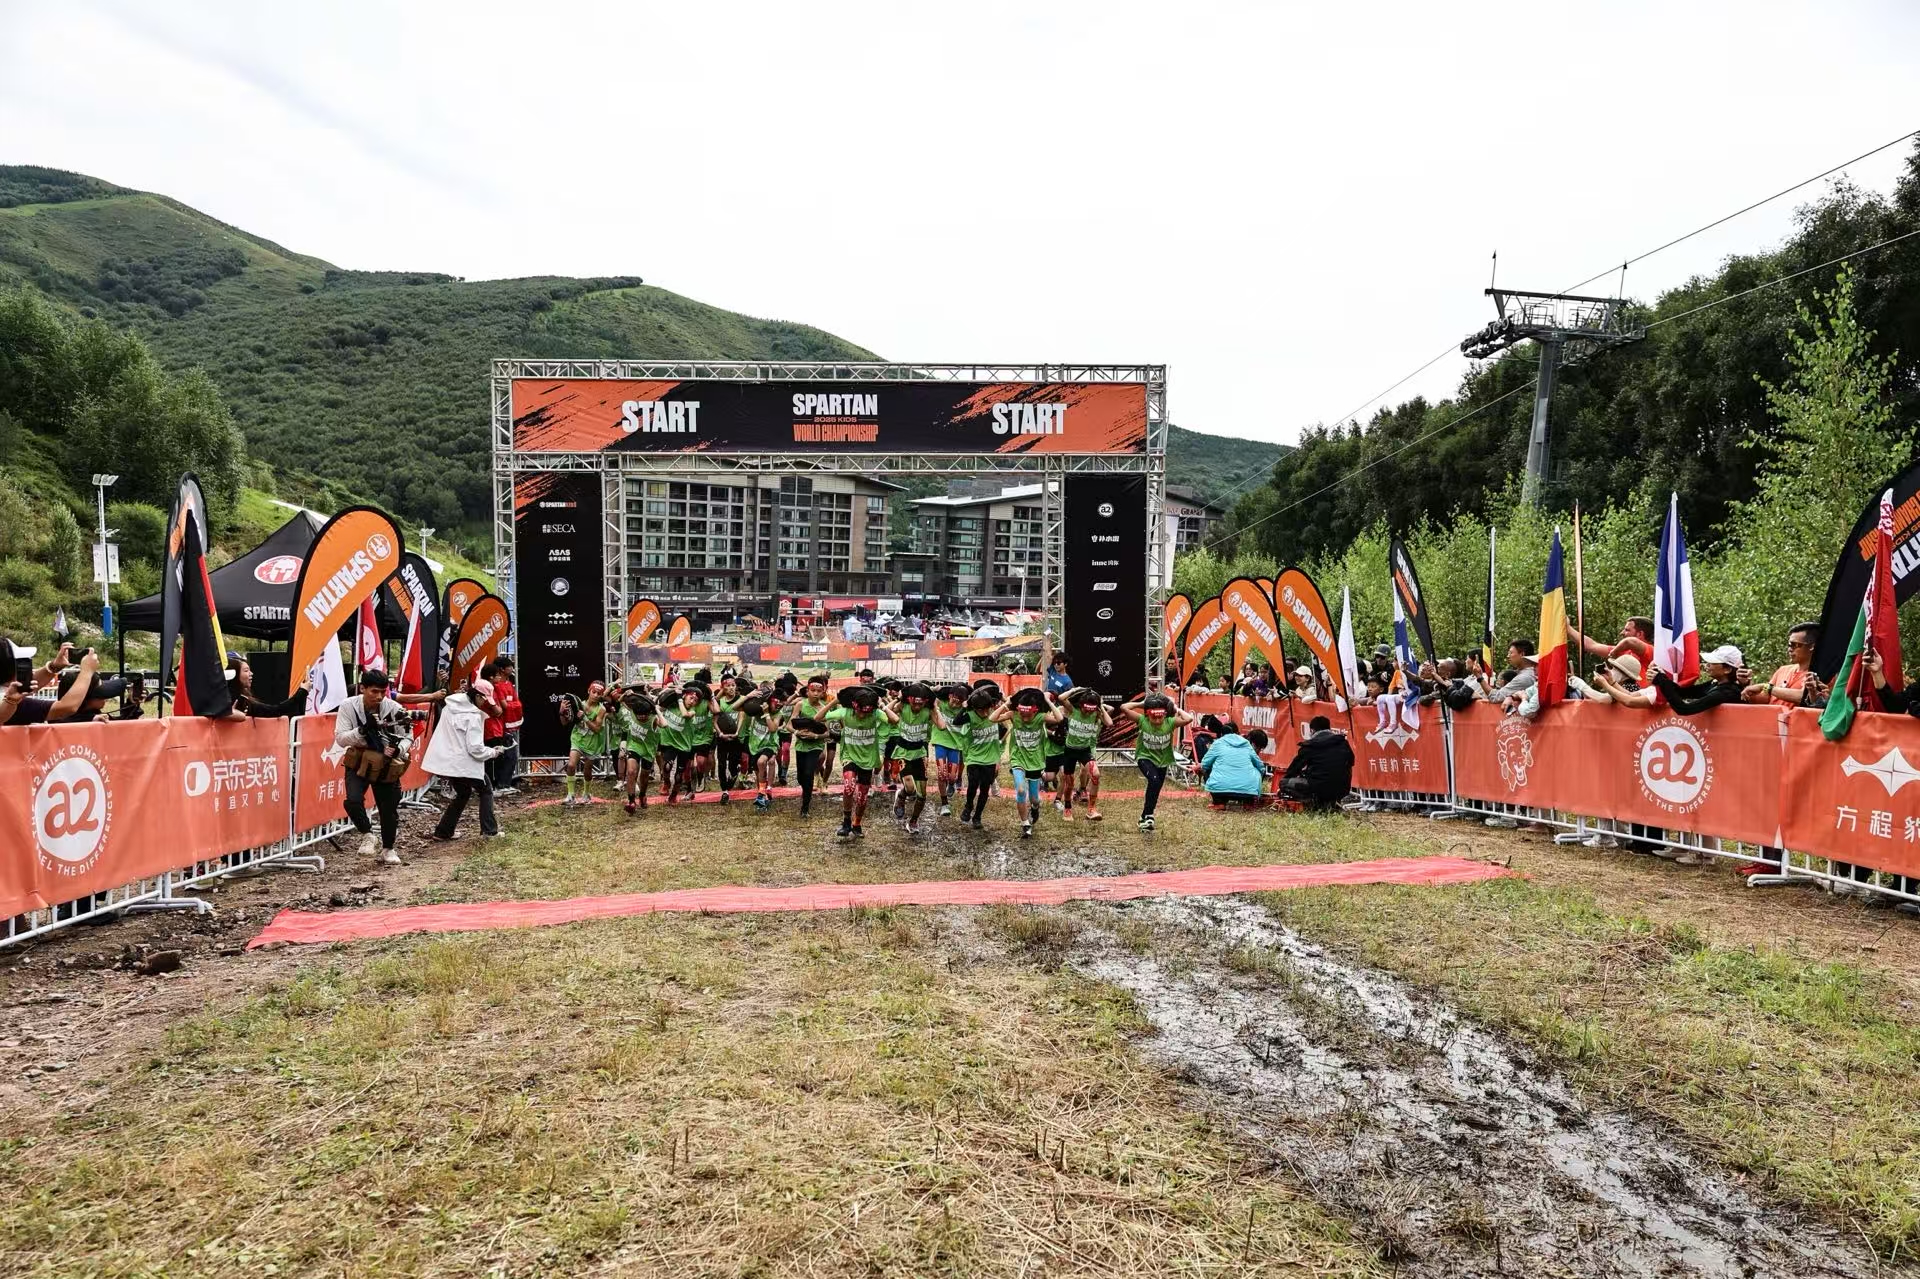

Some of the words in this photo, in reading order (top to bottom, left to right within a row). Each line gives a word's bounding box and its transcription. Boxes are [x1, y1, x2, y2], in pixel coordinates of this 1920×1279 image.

[622, 400, 700, 433] START
[792, 393, 878, 415] SPARTAN
[992, 403, 1068, 434] START
[793, 424, 821, 442] WORLD
[822, 424, 879, 442] CHAMPIONSHIP
[552, 524, 576, 533] SECA
[304, 550, 374, 630] SPARTAN
[401, 563, 435, 617] SPARTAN
[244, 605, 291, 620] SPARTA
[1238, 601, 1277, 646] SPARTAN
[1293, 598, 1332, 652] SPARTAN
[1188, 618, 1221, 657] SPARTAN
[845, 727, 876, 737] SPARTAN
[1243, 706, 1277, 728] SPARTAN
[1645, 719, 1668, 735] MILK
[1670, 717, 1710, 752] COMPANY
[41, 748, 65, 774] MILK
[70, 745, 110, 783] COMPANY
[212, 756, 278, 793] 京东买药
[1647, 741, 1698, 785] a2
[1639, 779, 1654, 802] FEEL
[1656, 798, 1673, 813] THE
[1679, 758, 1714, 814] DIFFERENCE
[44, 778, 99, 838] a2
[57, 863, 76, 877] THE
[80, 790, 113, 875] DIFFERENCE
